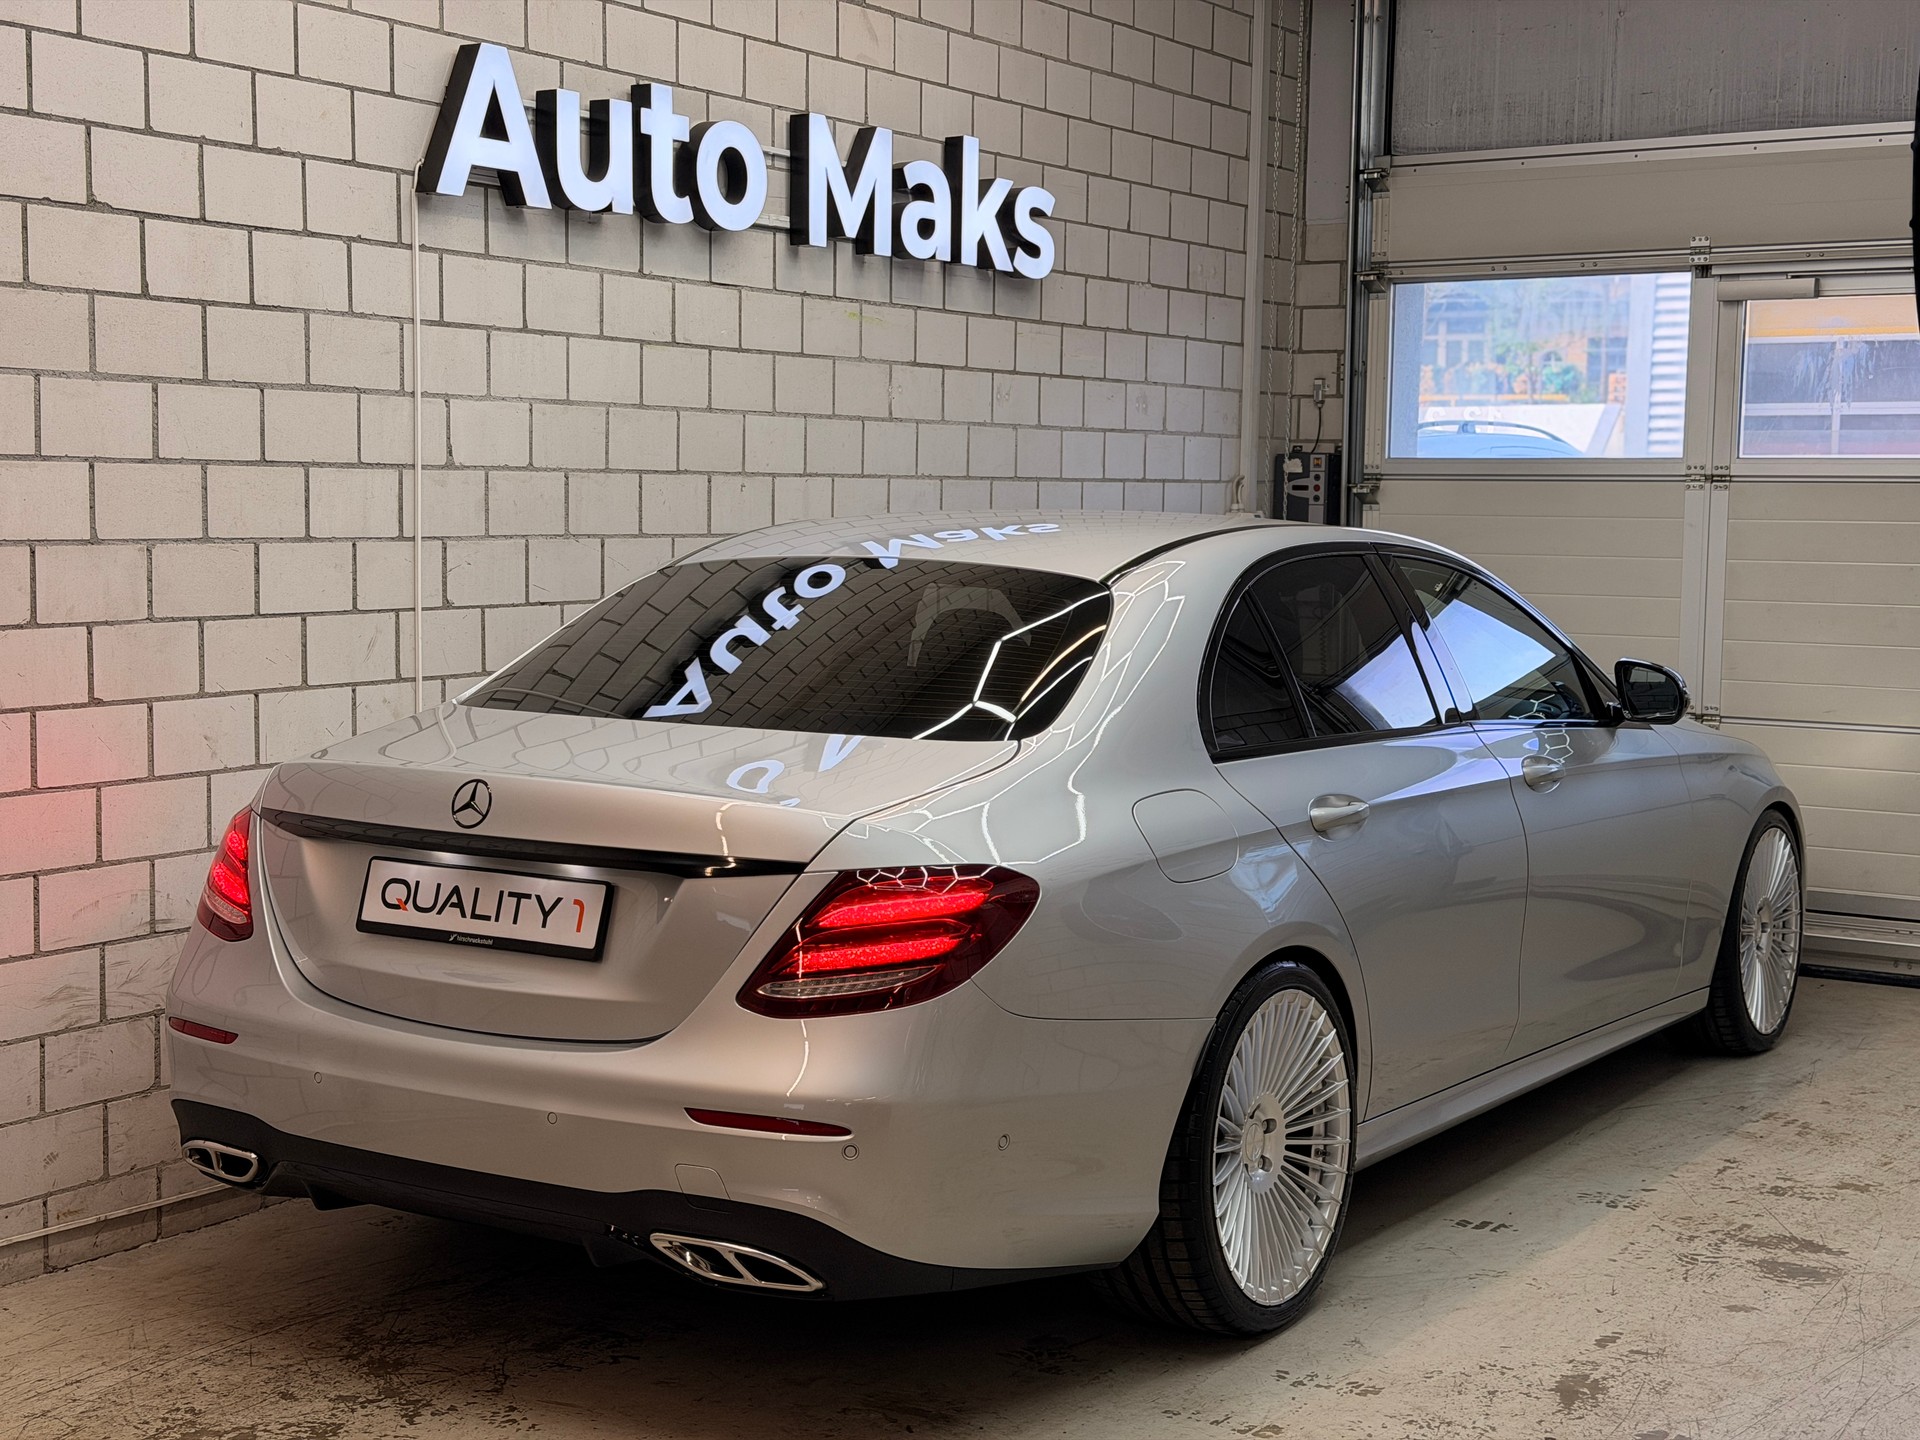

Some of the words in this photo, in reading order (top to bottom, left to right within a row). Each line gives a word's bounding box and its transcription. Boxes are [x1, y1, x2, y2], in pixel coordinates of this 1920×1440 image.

[424, 42, 768, 231] Auto
[794, 112, 1056, 279] Maks
[380, 877, 563, 929] QUALITY
[572, 898, 585, 933] 1
